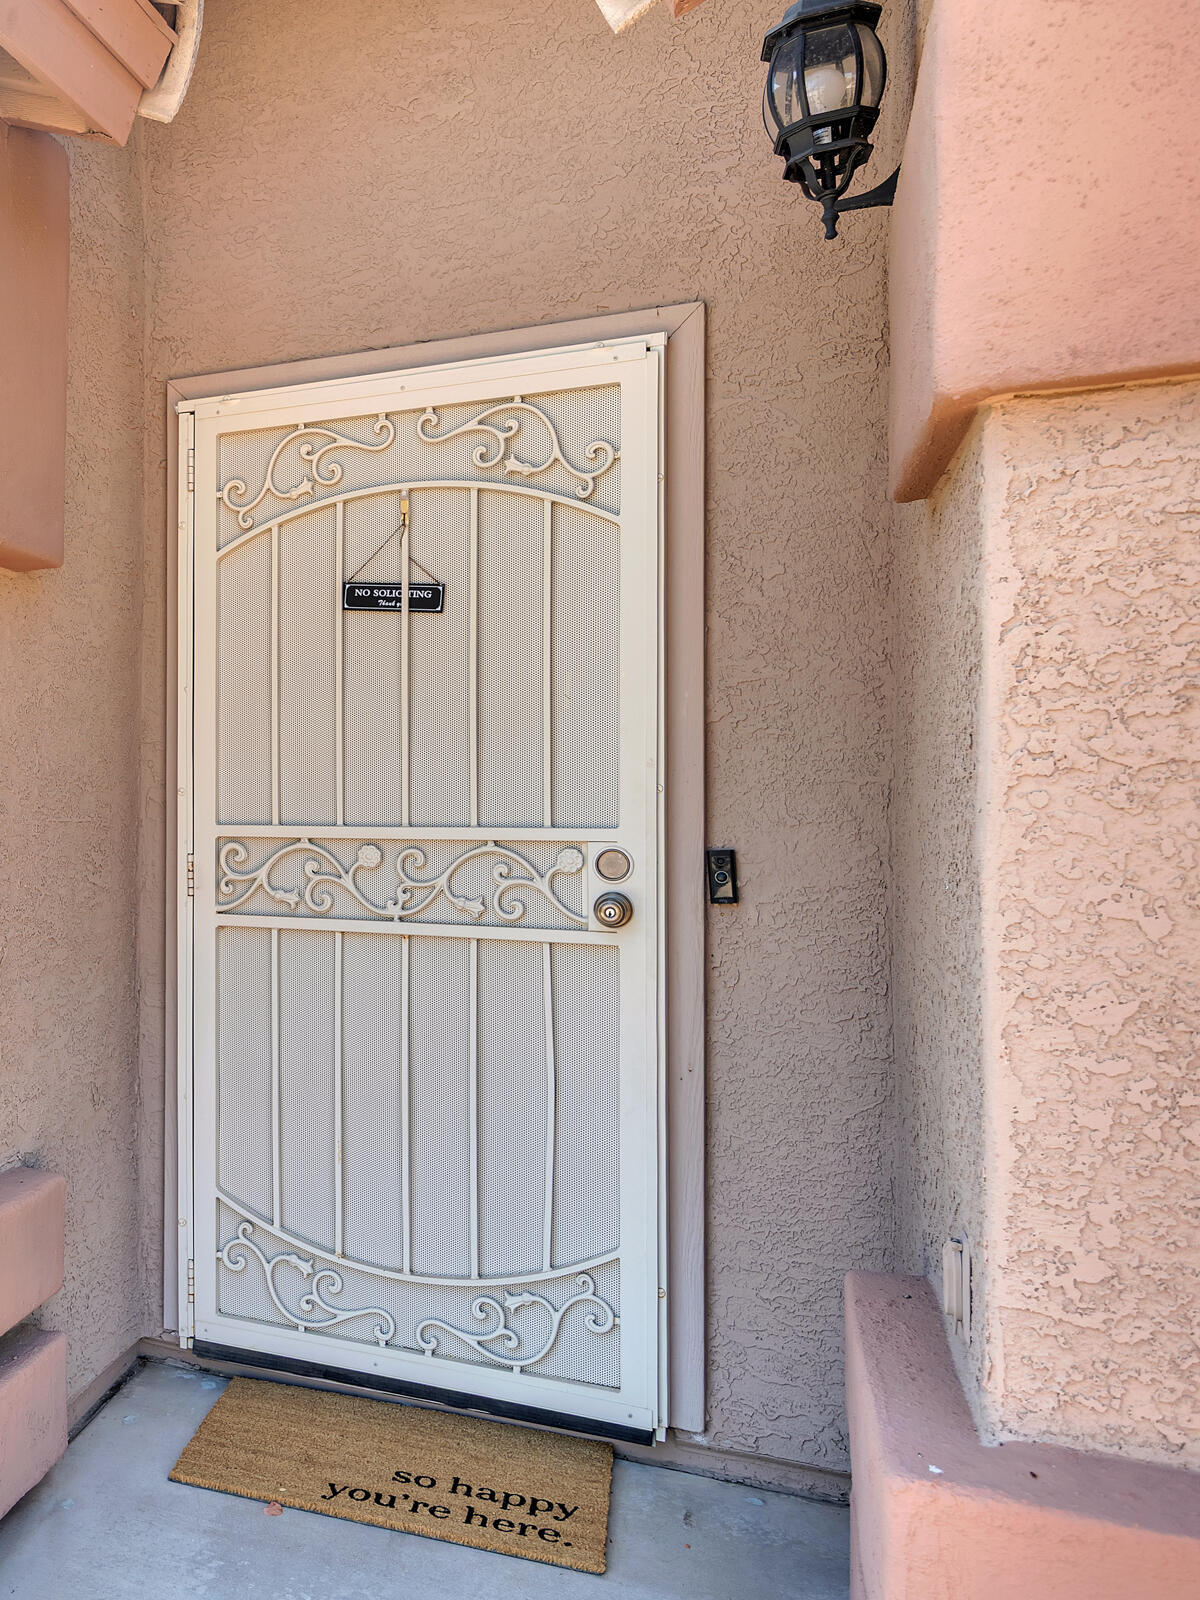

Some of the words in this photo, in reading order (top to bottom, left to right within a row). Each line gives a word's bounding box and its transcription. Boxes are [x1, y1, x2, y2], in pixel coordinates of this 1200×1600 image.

[373, 589, 432, 598] SOLICTING
[378, 599, 396, 607] Thank
[392, 1470, 437, 1489] so
[449, 1477, 579, 1522] happy
[321, 1482, 451, 1519] you're
[463, 1506, 573, 1547] here.
